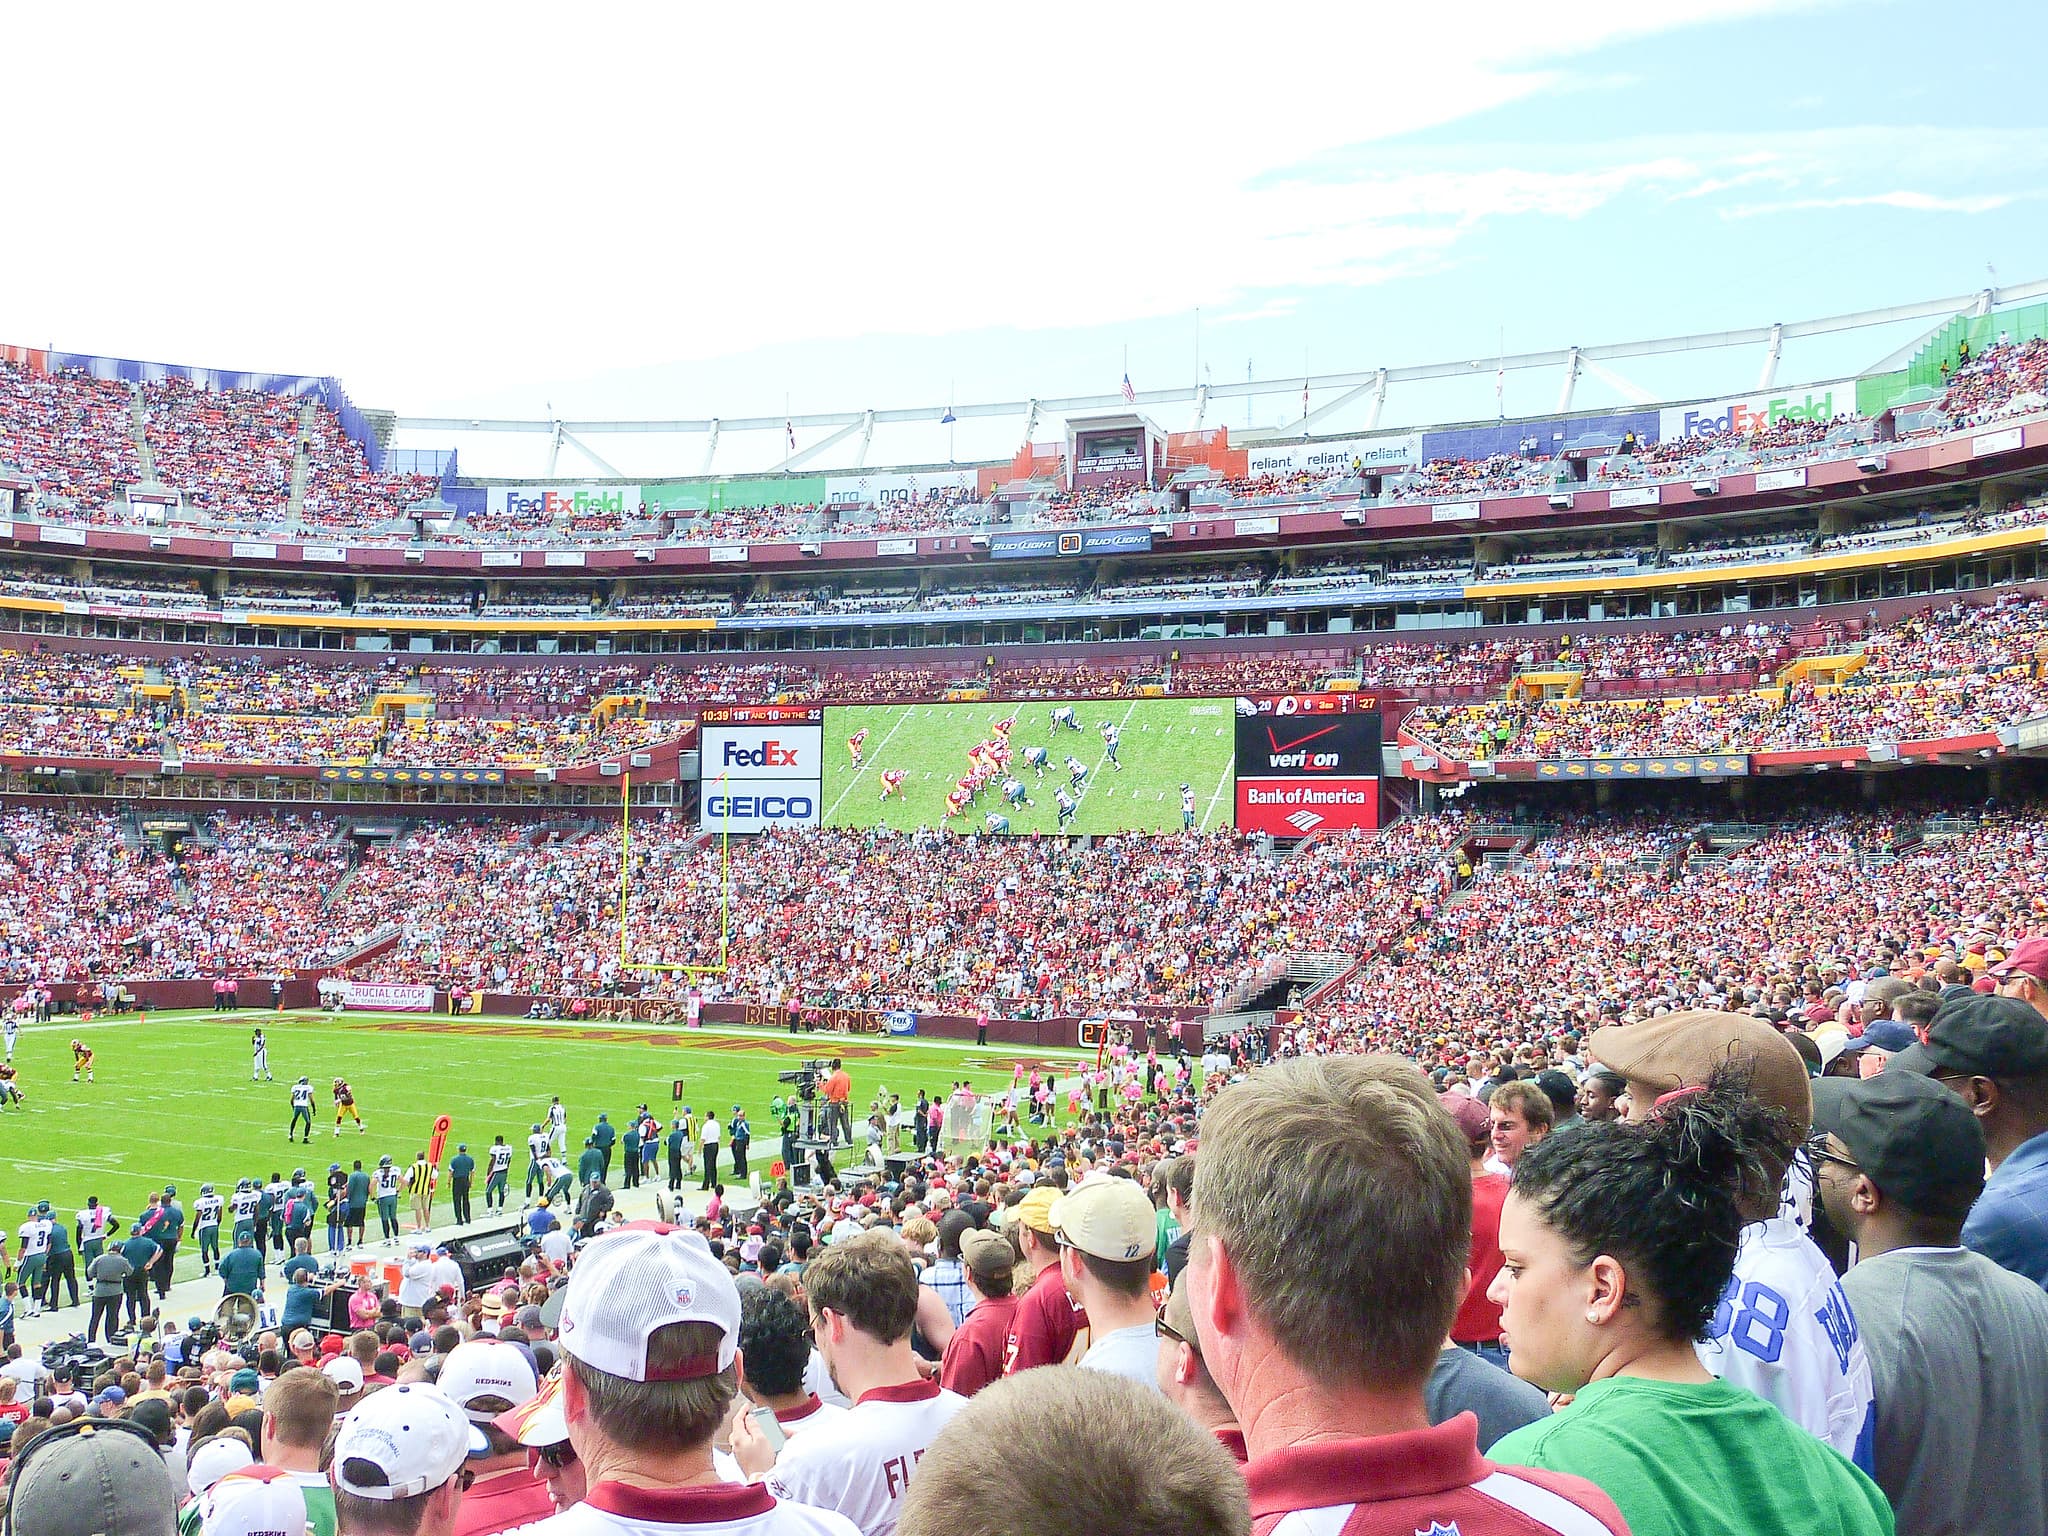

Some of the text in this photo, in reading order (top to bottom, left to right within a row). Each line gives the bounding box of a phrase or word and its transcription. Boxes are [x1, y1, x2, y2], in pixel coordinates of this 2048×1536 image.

[1684, 392, 1833, 438] FedExField
[1098, 456, 1144, 466] ASSISTANCE
[1252, 445, 1408, 470] reliant reliant reliant
[506, 491, 623, 514] FedExField
[992, 543, 1017, 551] BUD
[1062, 537, 1079, 550] 27
[1085, 534, 1150, 546] BUD LIGHT
[1258, 699, 1272, 711] 20
[1303, 698, 1312, 710] 6
[701, 710, 729, 720] 10:39
[733, 710, 751, 720] 1ST
[766, 710, 779, 720] 10
[807, 709, 821, 720] 32
[723, 741, 799, 767] FedEx
[1269, 750, 1340, 771] verizon
[1247, 787, 1365, 804] Bank of America
[707, 796, 813, 819] GEICO
[349, 986, 425, 999] CRUCIAL CATCH
[892, 1016, 908, 1026] FOX
[293, 1089, 308, 1101] 24
[774, 1162, 785, 1176] 30
[381, 1174, 397, 1189] 50
[36, 1230, 46, 1247] 3
[1123, 1243, 1140, 1259] 12
[475, 1378, 512, 1387] REDSKINS
